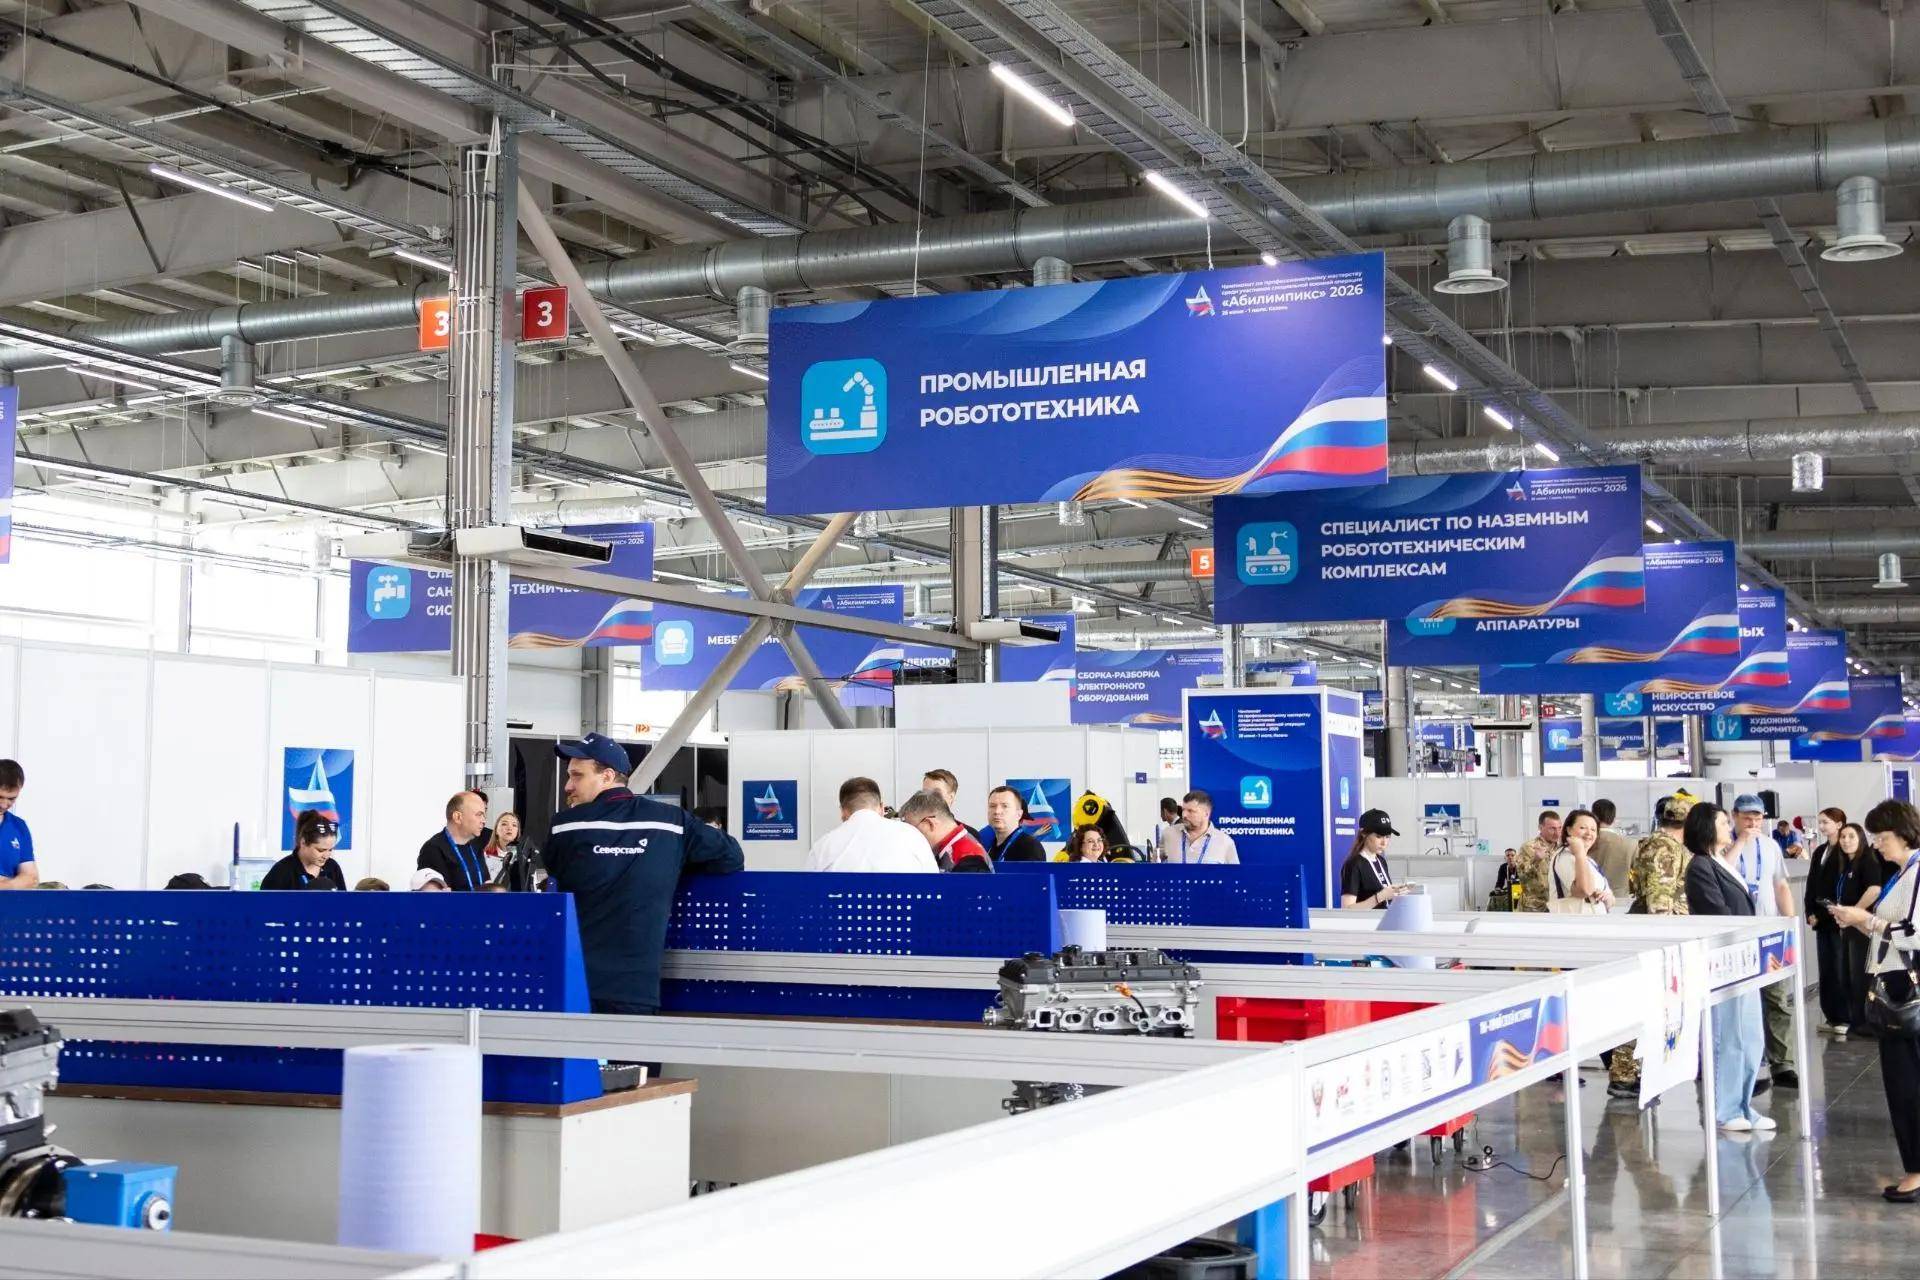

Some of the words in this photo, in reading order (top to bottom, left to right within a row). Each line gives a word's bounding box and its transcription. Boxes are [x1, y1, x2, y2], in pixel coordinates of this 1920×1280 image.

[1222, 290, 1326, 307] «Абилимпикс»
[1329, 284, 1364, 298] 2026
[537, 301, 553, 328] 3
[434, 310, 450, 337] 3
[920, 358, 1146, 394] ПРОМЫШЛЕННАЯ
[920, 394, 1140, 428] РОБОТОТЕХНИКА
[1531, 487, 1602, 496] «Абилимпикс»
[1604, 484, 1628, 493] 2026
[1320, 517, 1441, 536] СПЕЦИАЛИСТ
[1446, 516, 1473, 531] ПО
[1477, 510, 1589, 529] НАЗЕМНЫМ
[1321, 536, 1526, 558] РОБОТОТЕХНИЧЕСКИМ
[1199, 555, 1211, 570] 5
[1705, 556, 1724, 564] 2026
[1321, 562, 1447, 580] КОМПЛЕКСАМ
[1475, 618, 1580, 632] АППАРАТУРЫ
[1738, 626, 1765, 637] ЫХ
[1077, 670, 1161, 680] СБОРКА-РАЗБОРКА
[1077, 682, 1146, 691] ЭЛЕКТРОННОГО
[1077, 693, 1149, 703] ОБОРУДОВАНИЯ
[1652, 702, 1715, 712] ИСКУССТВО
[1750, 716, 1801, 725] ХУДОЖНИК-
[1750, 725, 1809, 734] ОФОРМИТЕЛЬ
[1218, 816, 1296, 825] ПРОМЫШЛЕННАЯ
[592, 844, 645, 857] Северсталь
